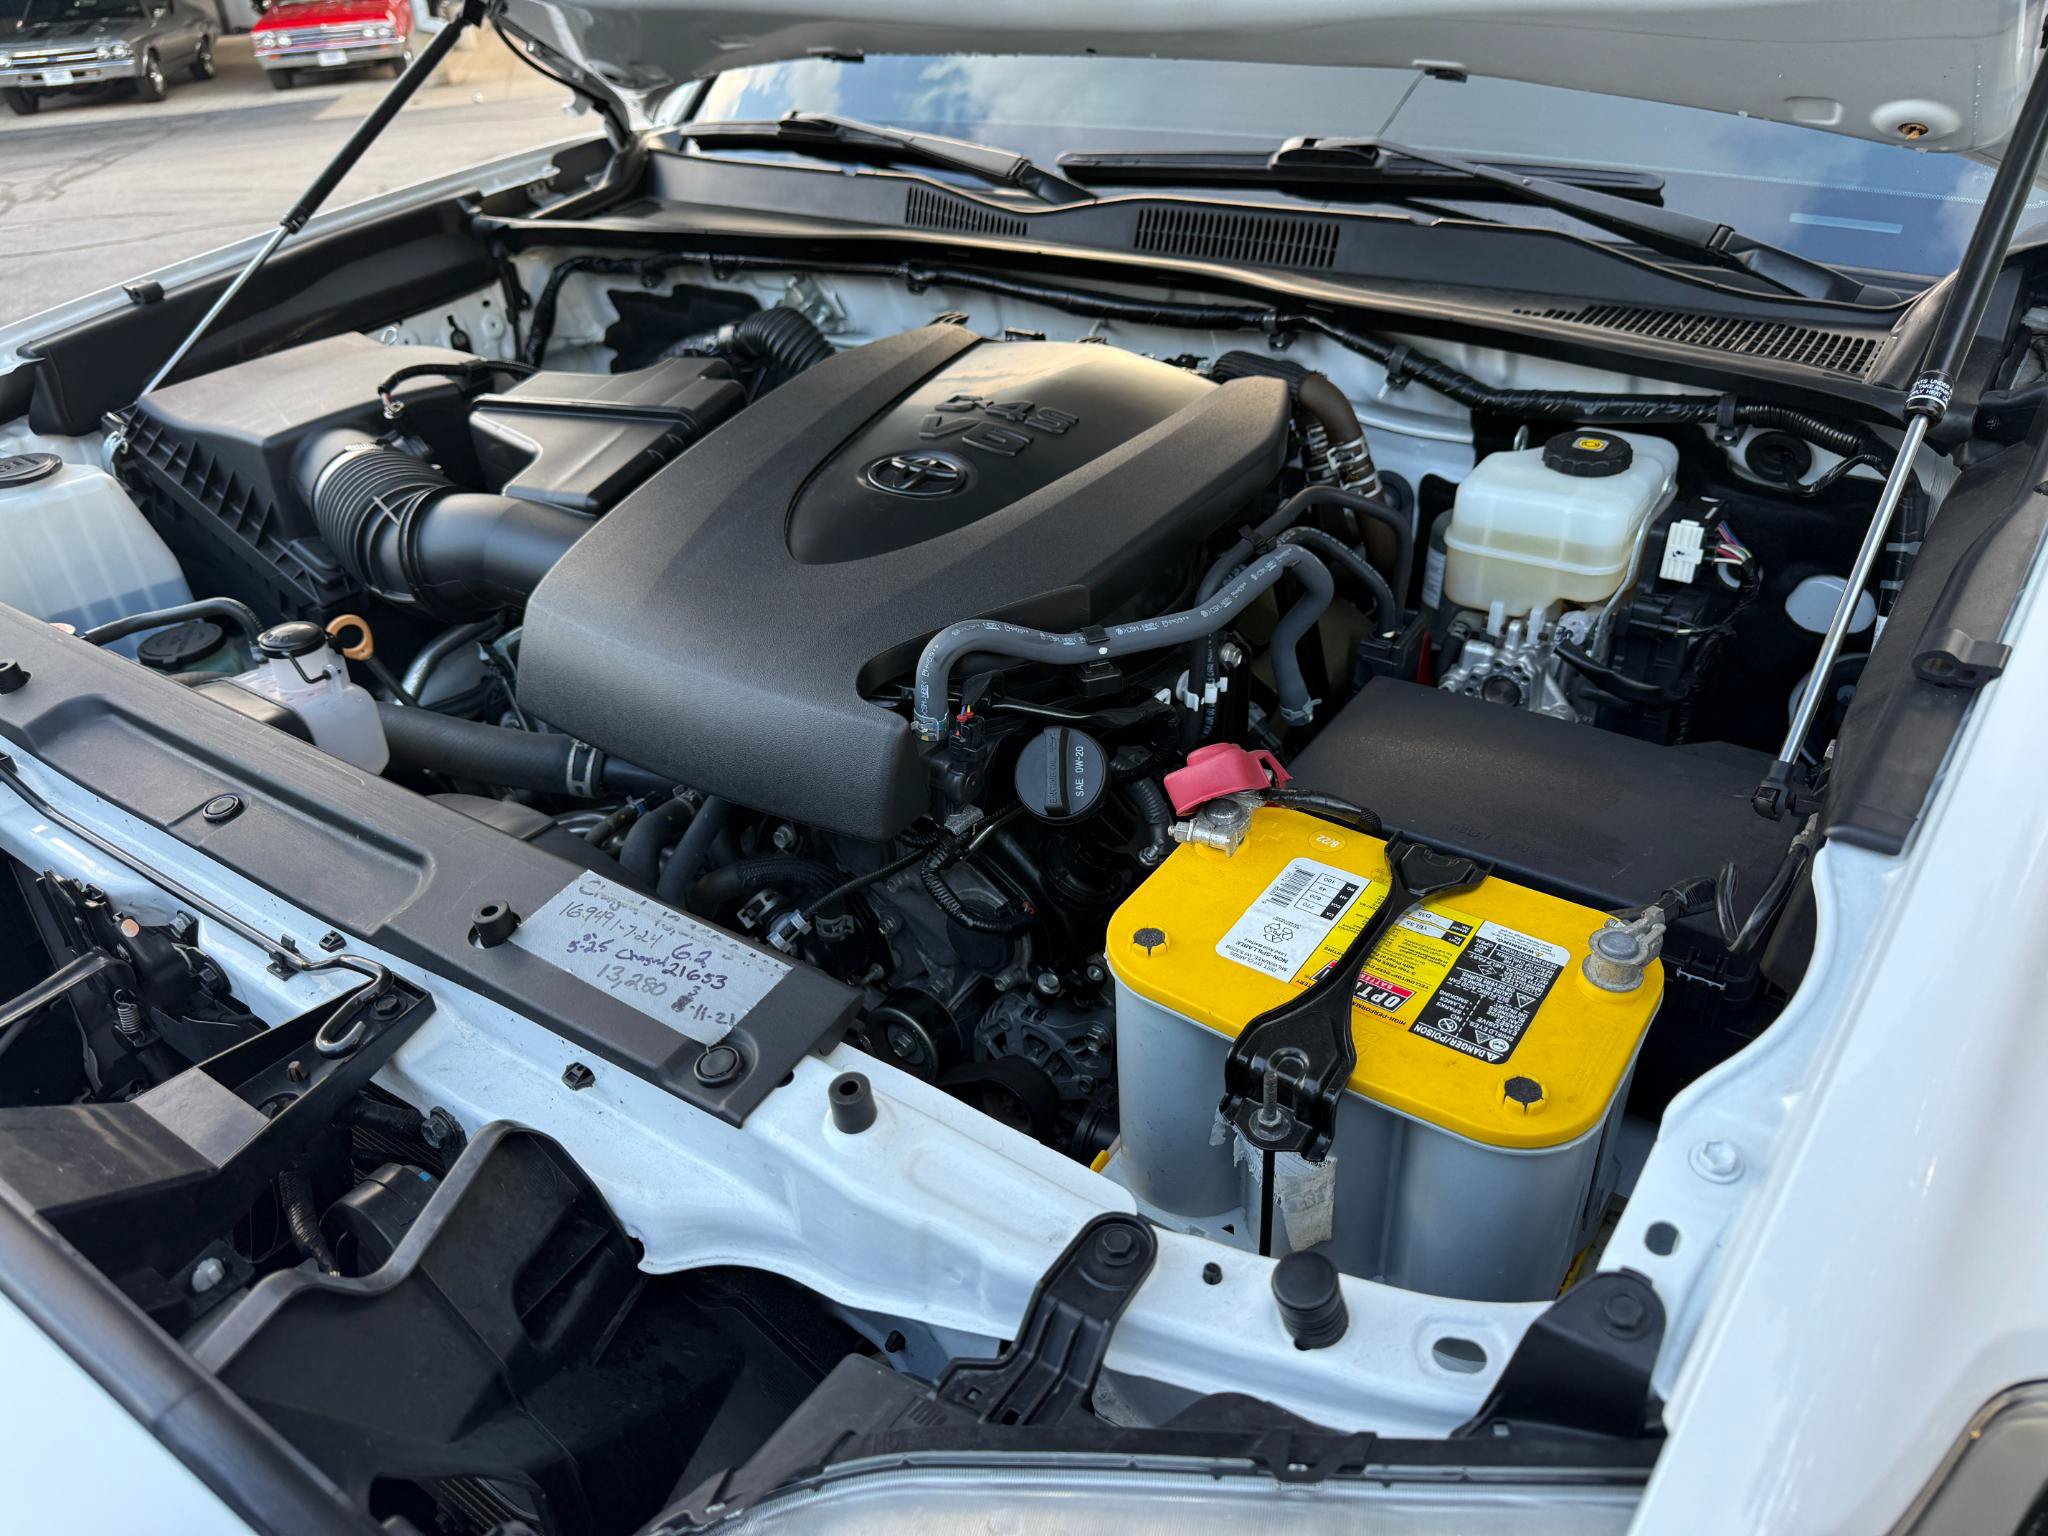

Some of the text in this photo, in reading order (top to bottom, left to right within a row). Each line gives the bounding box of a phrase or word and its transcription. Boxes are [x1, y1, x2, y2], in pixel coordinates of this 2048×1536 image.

[1075, 746, 1084, 797] SAE 0W-20
[1316, 835, 1340, 848] 8/22
[1236, 941, 1289, 964] NON-SPILLABLE
[1474, 943, 1489, 951] NOT
[1496, 937, 1534, 954] WARNING:
[1486, 959, 1505, 969] HELP
[1359, 974, 1394, 990] BATTER
[1460, 975, 1513, 998] CAUSE BLINDNESS
[1483, 979, 1506, 990] SEVERE
[1439, 990, 1469, 1004] SMOKING
[1448, 977, 1510, 1003] SULFURIC ACID CAN
[1506, 986, 1516, 994] OR
[1436, 1001, 1462, 1015] SPARKS
[1439, 996, 1466, 1010] FLAMES
[1450, 1014, 1463, 1022] NO
[1486, 1009, 1523, 1027] CAN CAUSE
[1489, 1005, 1526, 1023] BLINDNESS
[1476, 1017, 1518, 1036] EXPLOSIVE
[1495, 1018, 1521, 1031] GASES
[1414, 1024, 1486, 1057] DANGER/POISON
[1488, 1028, 1514, 1042] SHIELD
